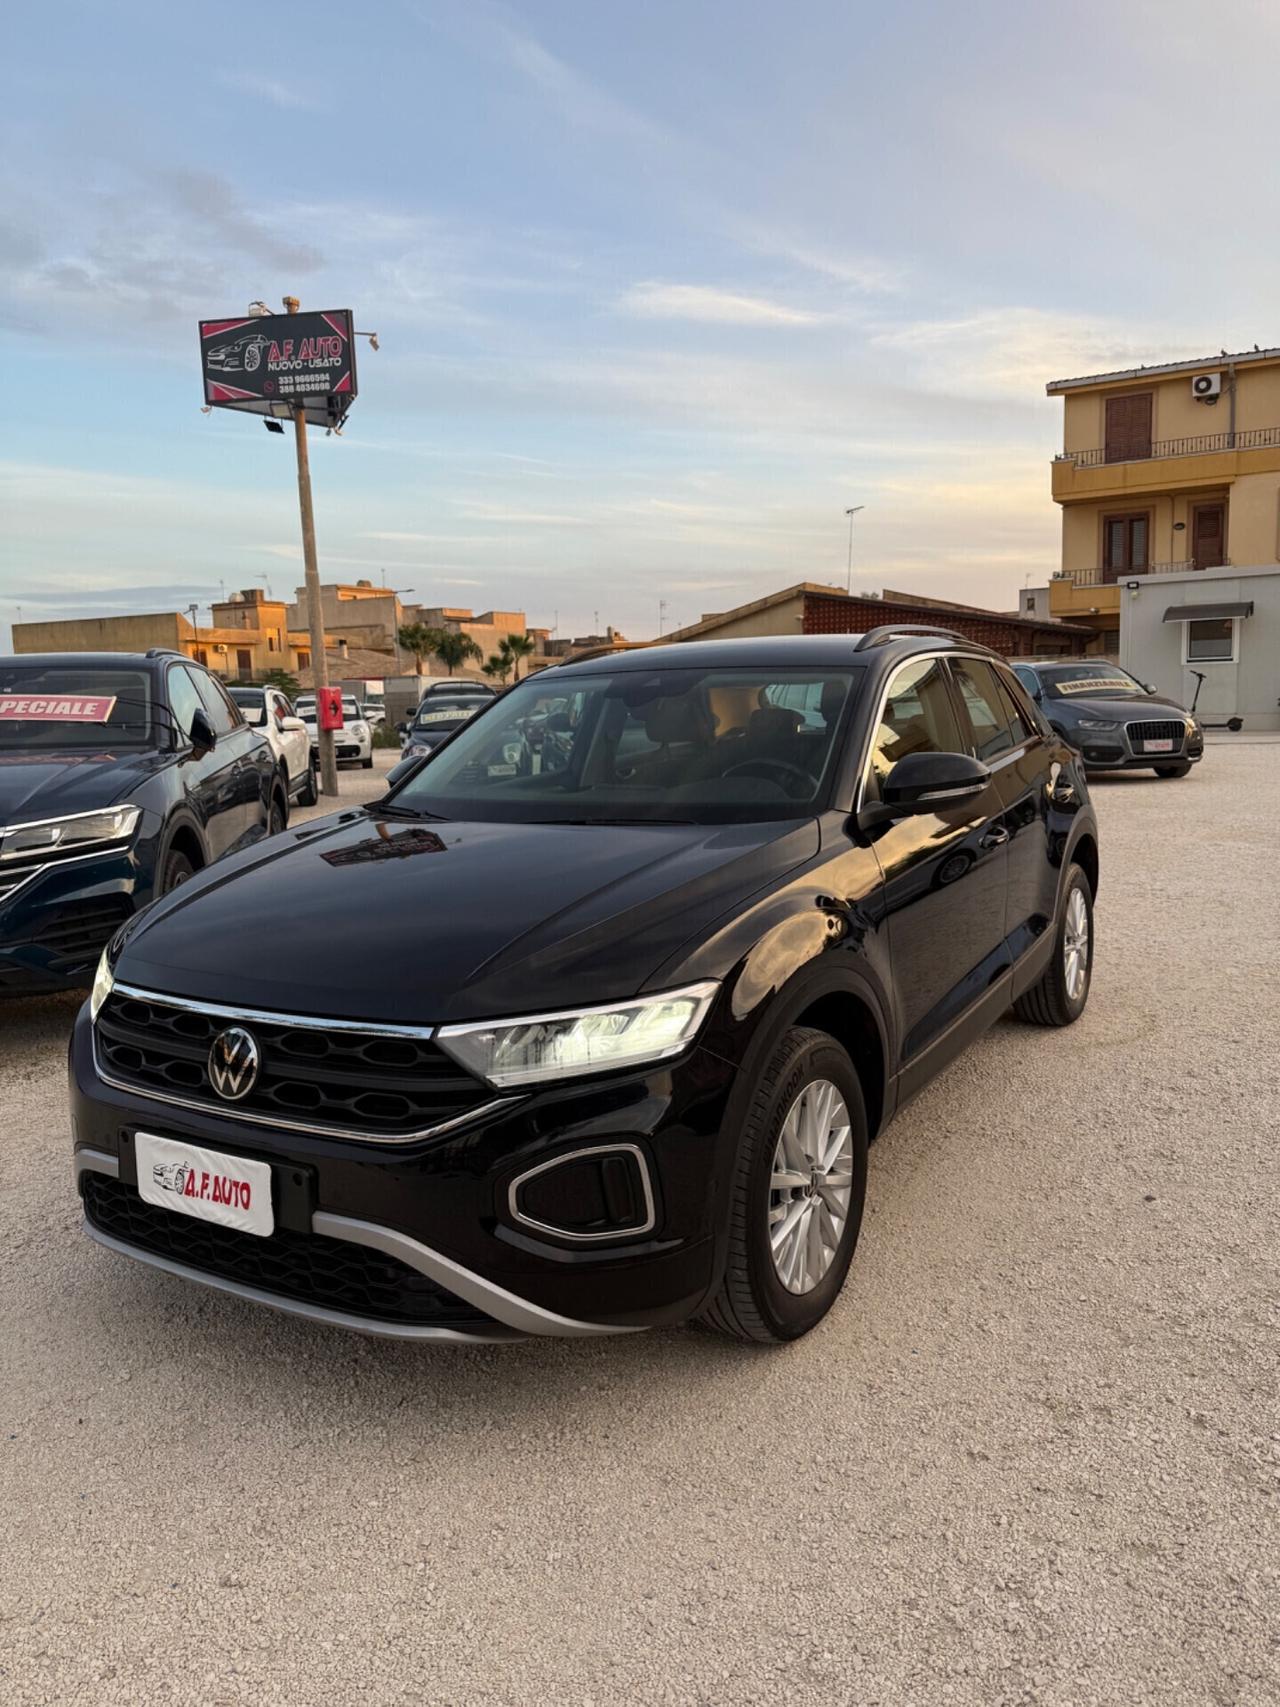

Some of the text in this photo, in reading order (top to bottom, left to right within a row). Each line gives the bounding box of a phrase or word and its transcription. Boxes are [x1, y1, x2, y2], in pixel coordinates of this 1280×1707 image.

[267, 336, 343, 362] A.F. AUTO
[268, 360, 303, 371] NUOVO
[308, 357, 342, 368] USATO
